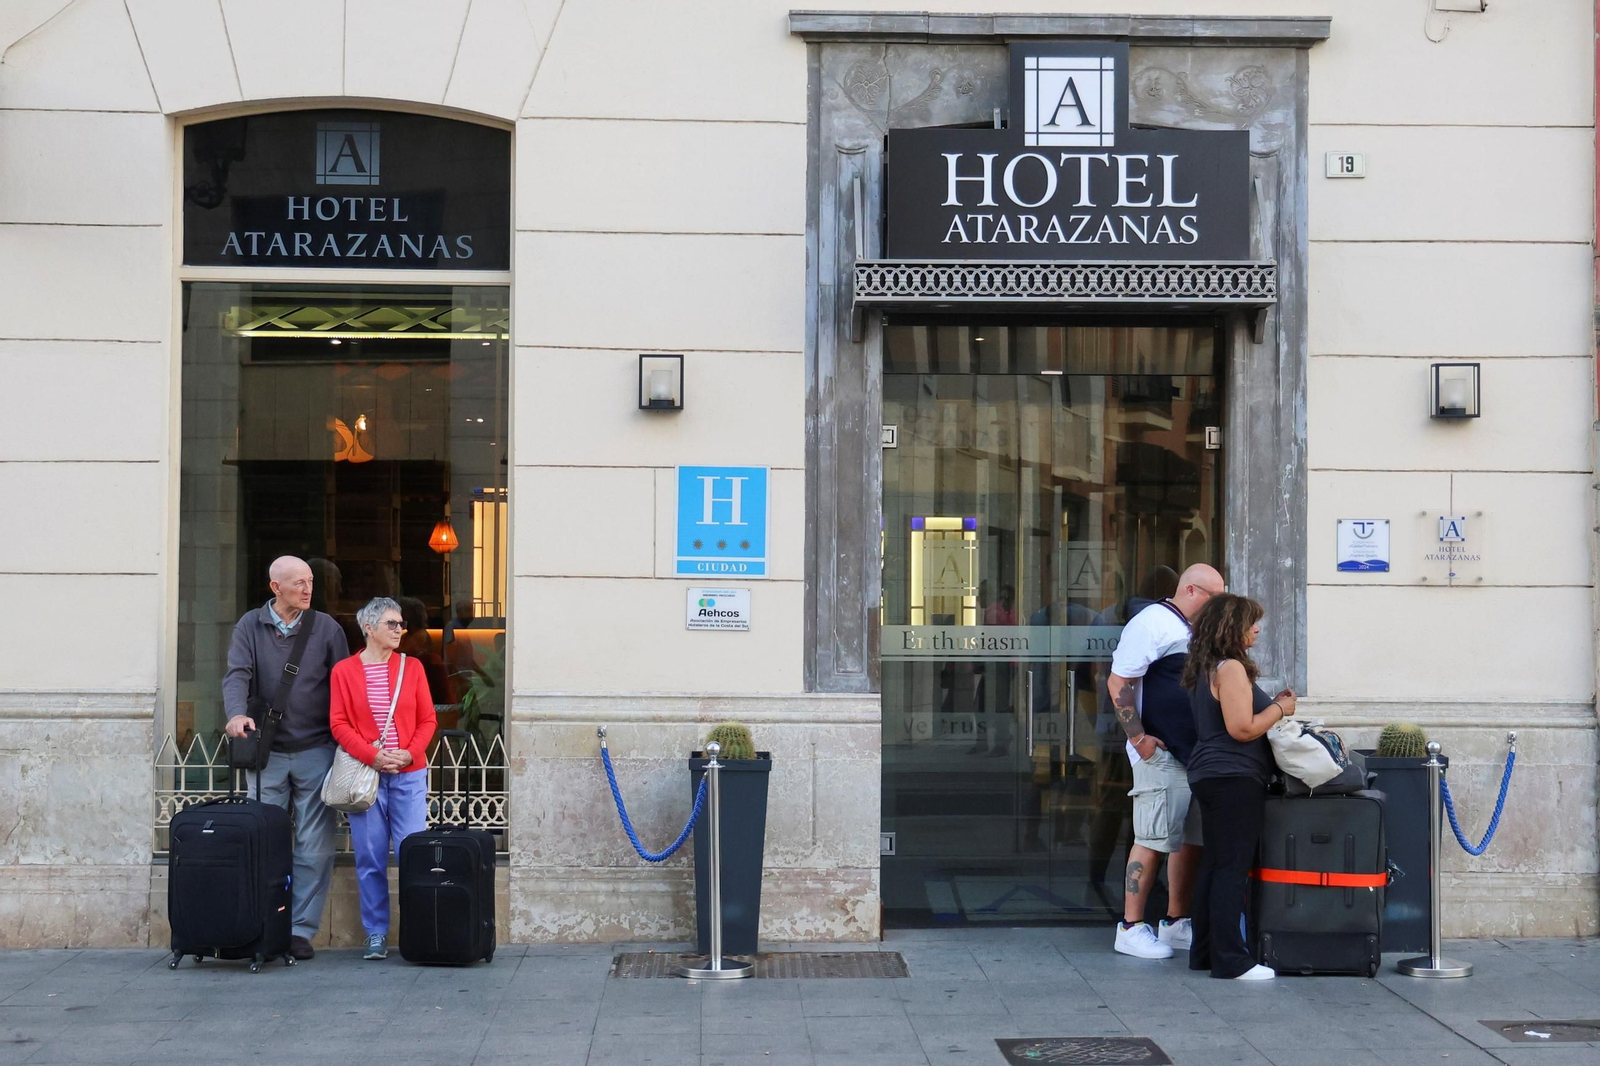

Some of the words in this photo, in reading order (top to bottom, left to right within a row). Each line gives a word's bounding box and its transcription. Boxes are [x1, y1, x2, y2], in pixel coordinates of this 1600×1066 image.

[1043, 76, 1096, 127] A
[329, 133, 367, 173] A
[1338, 156, 1354, 173] 19
[941, 152, 1198, 208] HOTEL
[287, 196, 409, 222] HOTEL
[941, 214, 1199, 245] ATARAZANAS
[221, 231, 474, 260] ATARAZANAS
[696, 475, 749, 526] H
[1445, 521, 1460, 537] A
[697, 562, 748, 572] CIUDAD
[934, 551, 966, 584] A
[1072, 553, 1100, 585] A
[698, 608, 740, 618] Aehcos
[901, 629, 1029, 650] Enthusiasm
